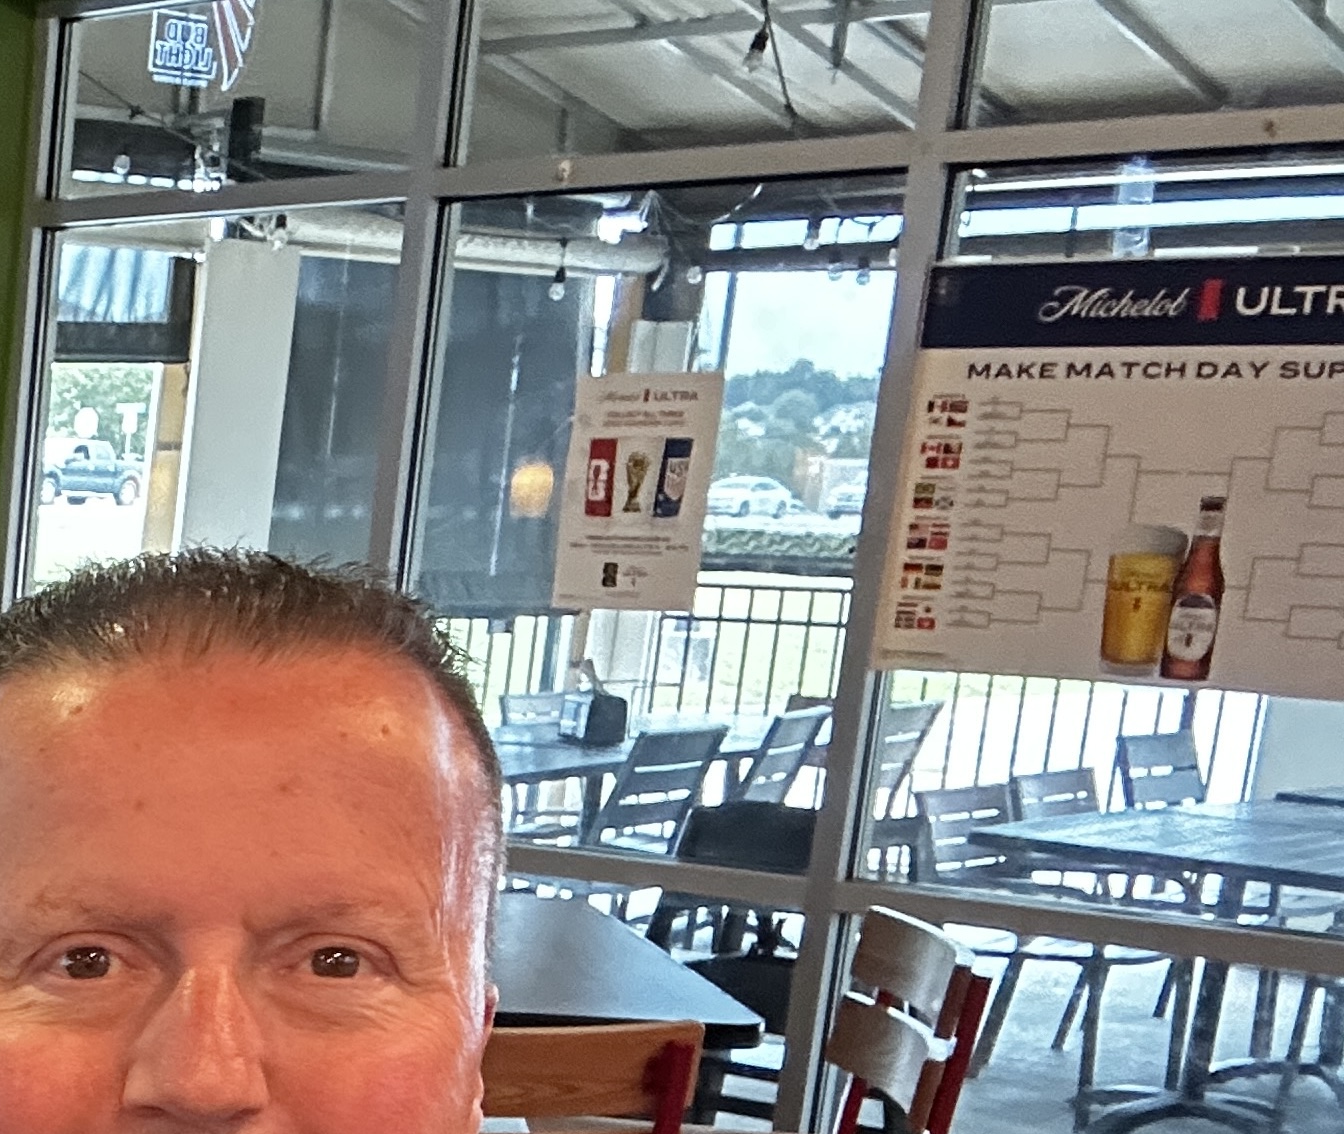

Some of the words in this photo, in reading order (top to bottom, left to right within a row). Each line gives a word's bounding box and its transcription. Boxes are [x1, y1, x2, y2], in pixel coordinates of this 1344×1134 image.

[1038, 285, 1190, 323] Michelob
[967, 362, 1057, 380] MAKE
[1065, 361, 1188, 380] MATCH
[1194, 361, 1271, 380] DAY
